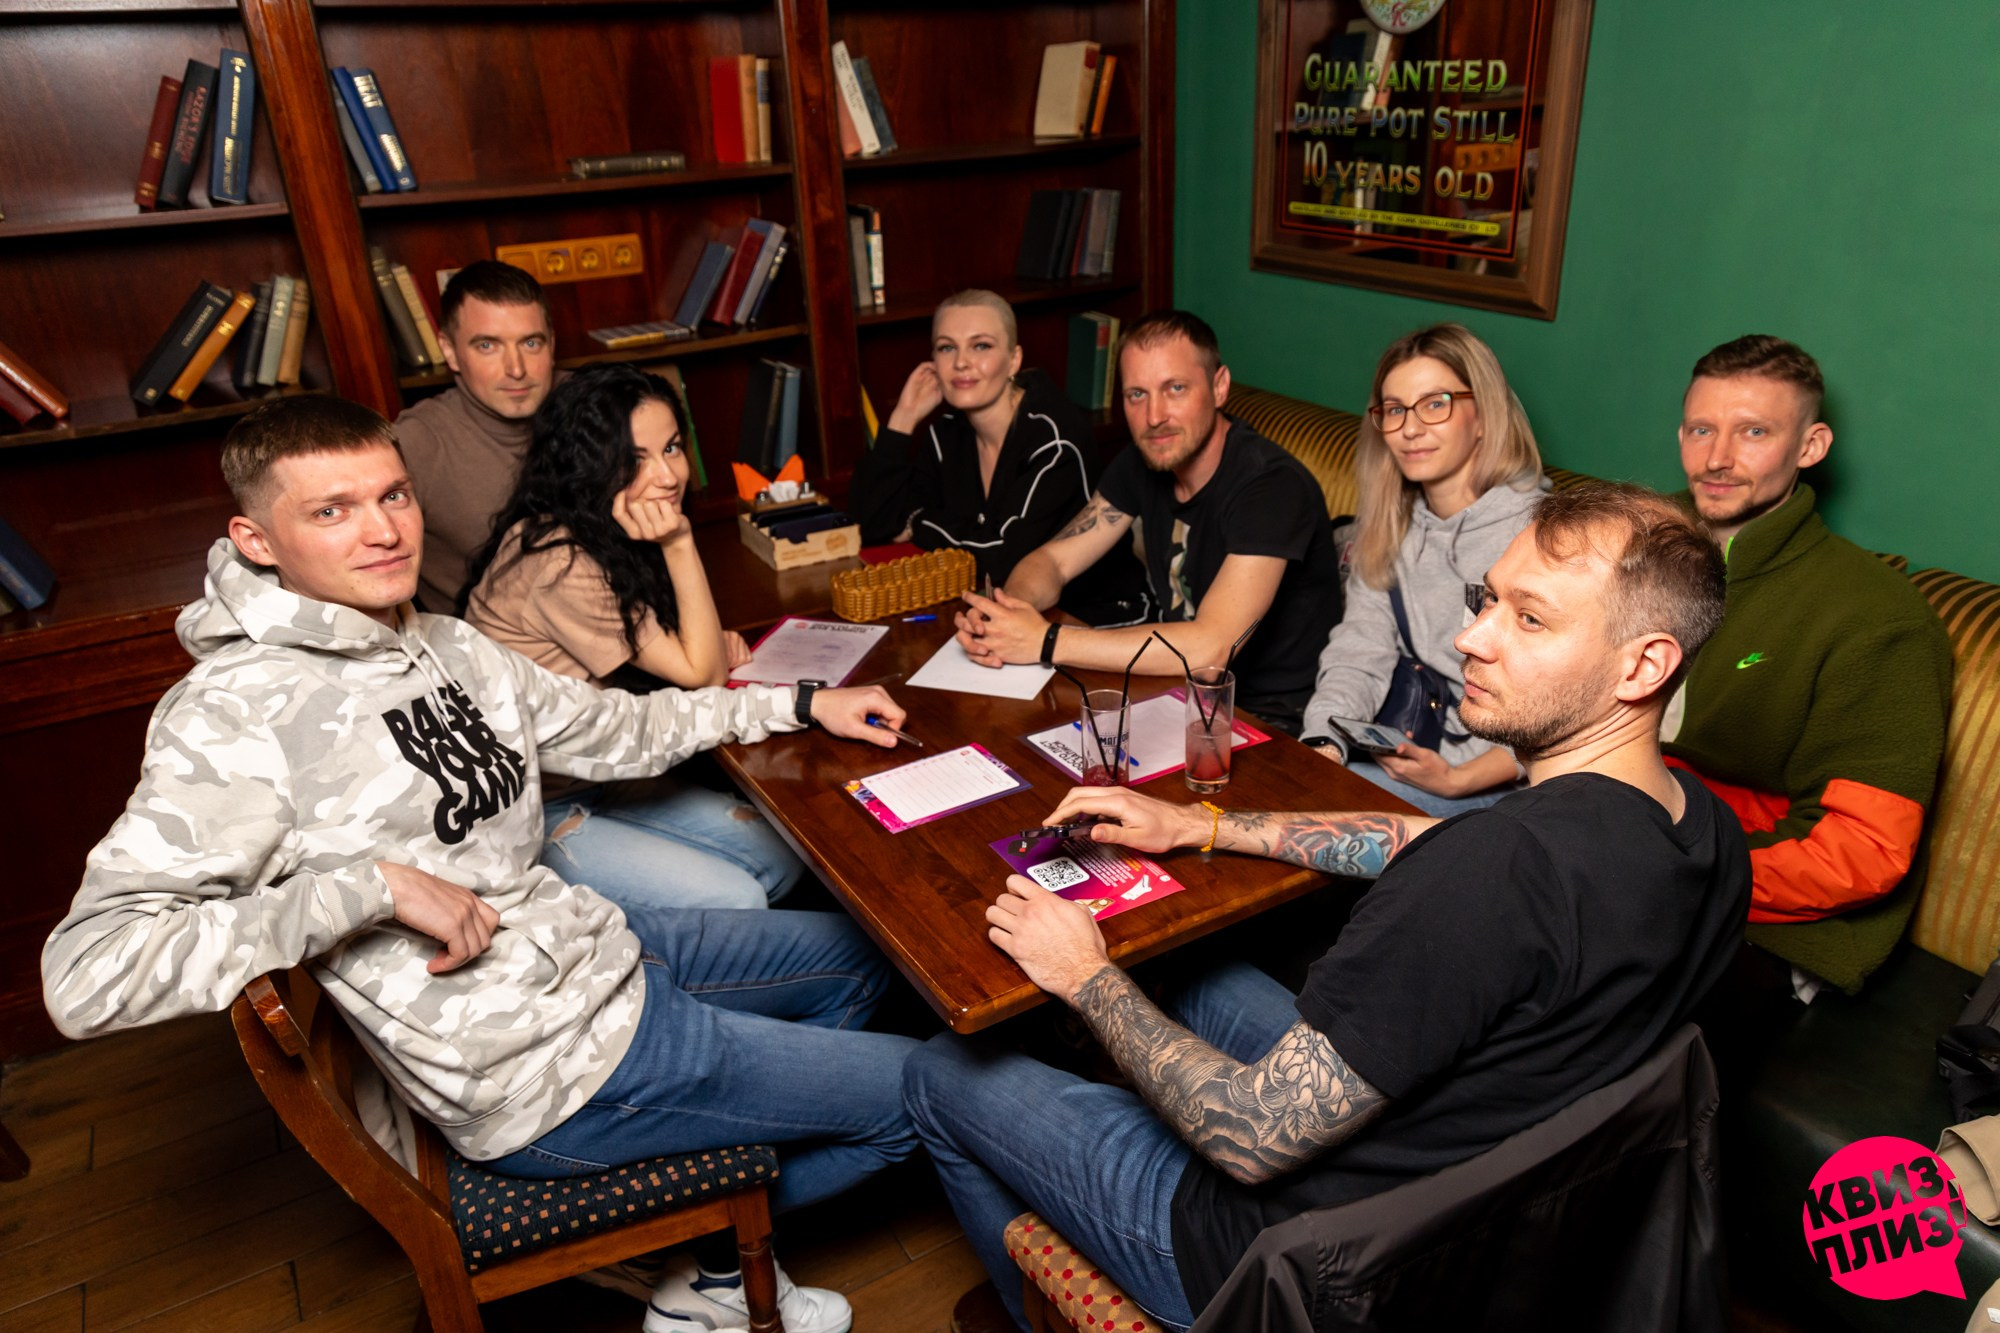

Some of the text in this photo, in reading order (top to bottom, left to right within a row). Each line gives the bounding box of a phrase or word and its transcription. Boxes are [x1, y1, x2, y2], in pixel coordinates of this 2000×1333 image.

[1304, 52, 1508, 93] GUARANTEED
[1294, 101, 1516, 144] PURE POT STILL
[1303, 139, 1495, 201] 10 YEARS OLD
[402, 719, 514, 797] YOUR
[1058, 753, 1084, 773] РОСТО
[433, 750, 527, 845] GAME
